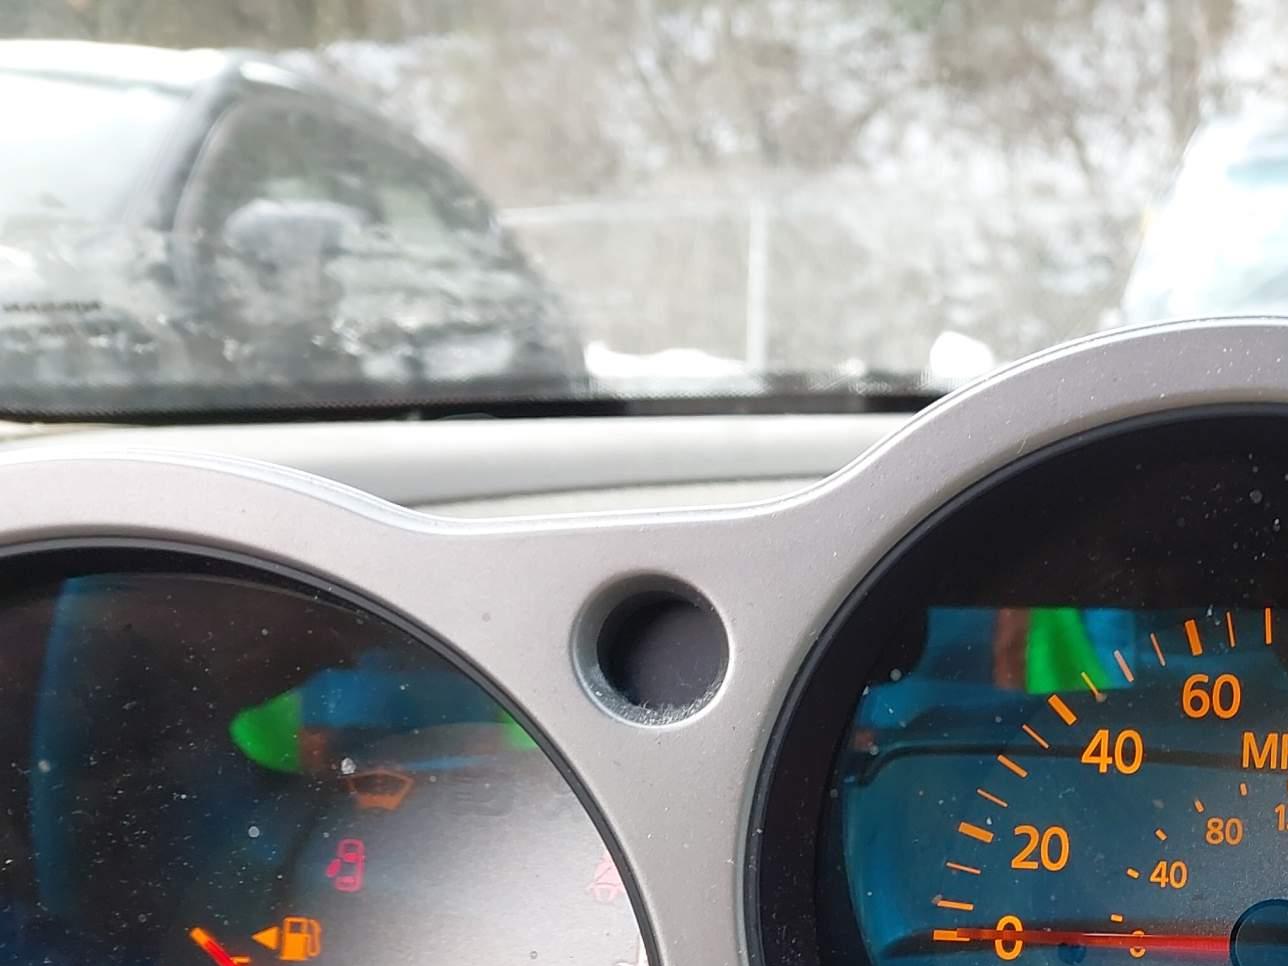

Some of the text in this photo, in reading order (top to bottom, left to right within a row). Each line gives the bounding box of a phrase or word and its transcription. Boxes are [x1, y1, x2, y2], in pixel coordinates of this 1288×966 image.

[1183, 674, 1241, 719] 60
[1081, 728, 1143, 775] 40
[1012, 825, 1069, 871] 20
[1205, 817, 1243, 845] 80
[1149, 860, 1188, 889] 40
[994, 914, 1024, 961] 0
